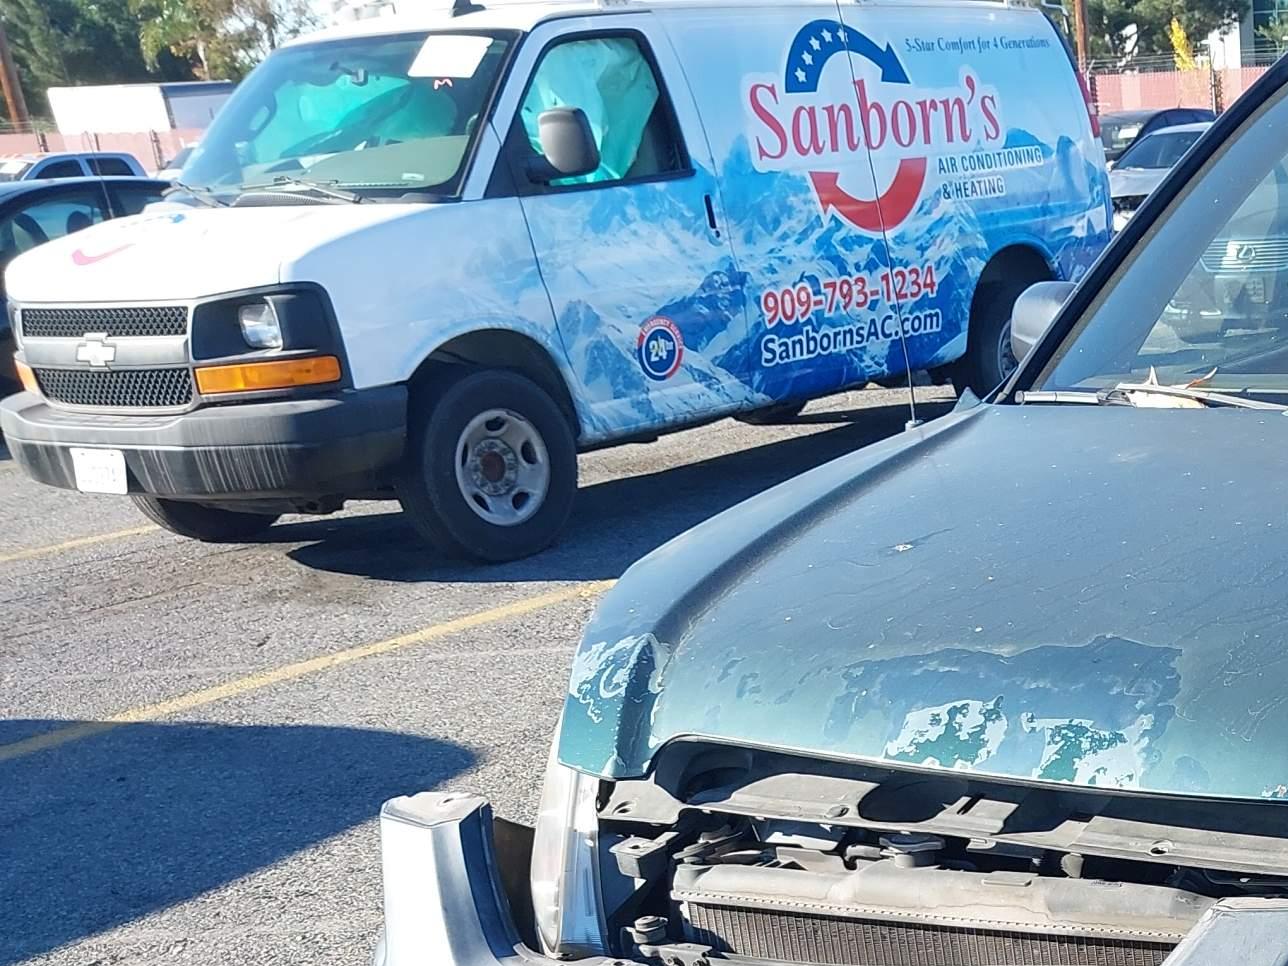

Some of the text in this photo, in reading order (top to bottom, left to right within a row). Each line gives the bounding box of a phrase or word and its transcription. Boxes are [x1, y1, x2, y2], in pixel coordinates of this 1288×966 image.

[905, 37, 935, 52] 5-Star
[937, 36, 975, 54] Comfort
[977, 36, 990, 53] for
[1000, 35, 1050, 49] Generations
[749, 75, 1000, 160] Sanborn's
[938, 147, 1042, 175] AIR CONDITIONING
[942, 178, 1004, 200] & HEATING
[763, 265, 937, 325] 909-793-1234
[763, 309, 940, 365] SanbornsAC.com
